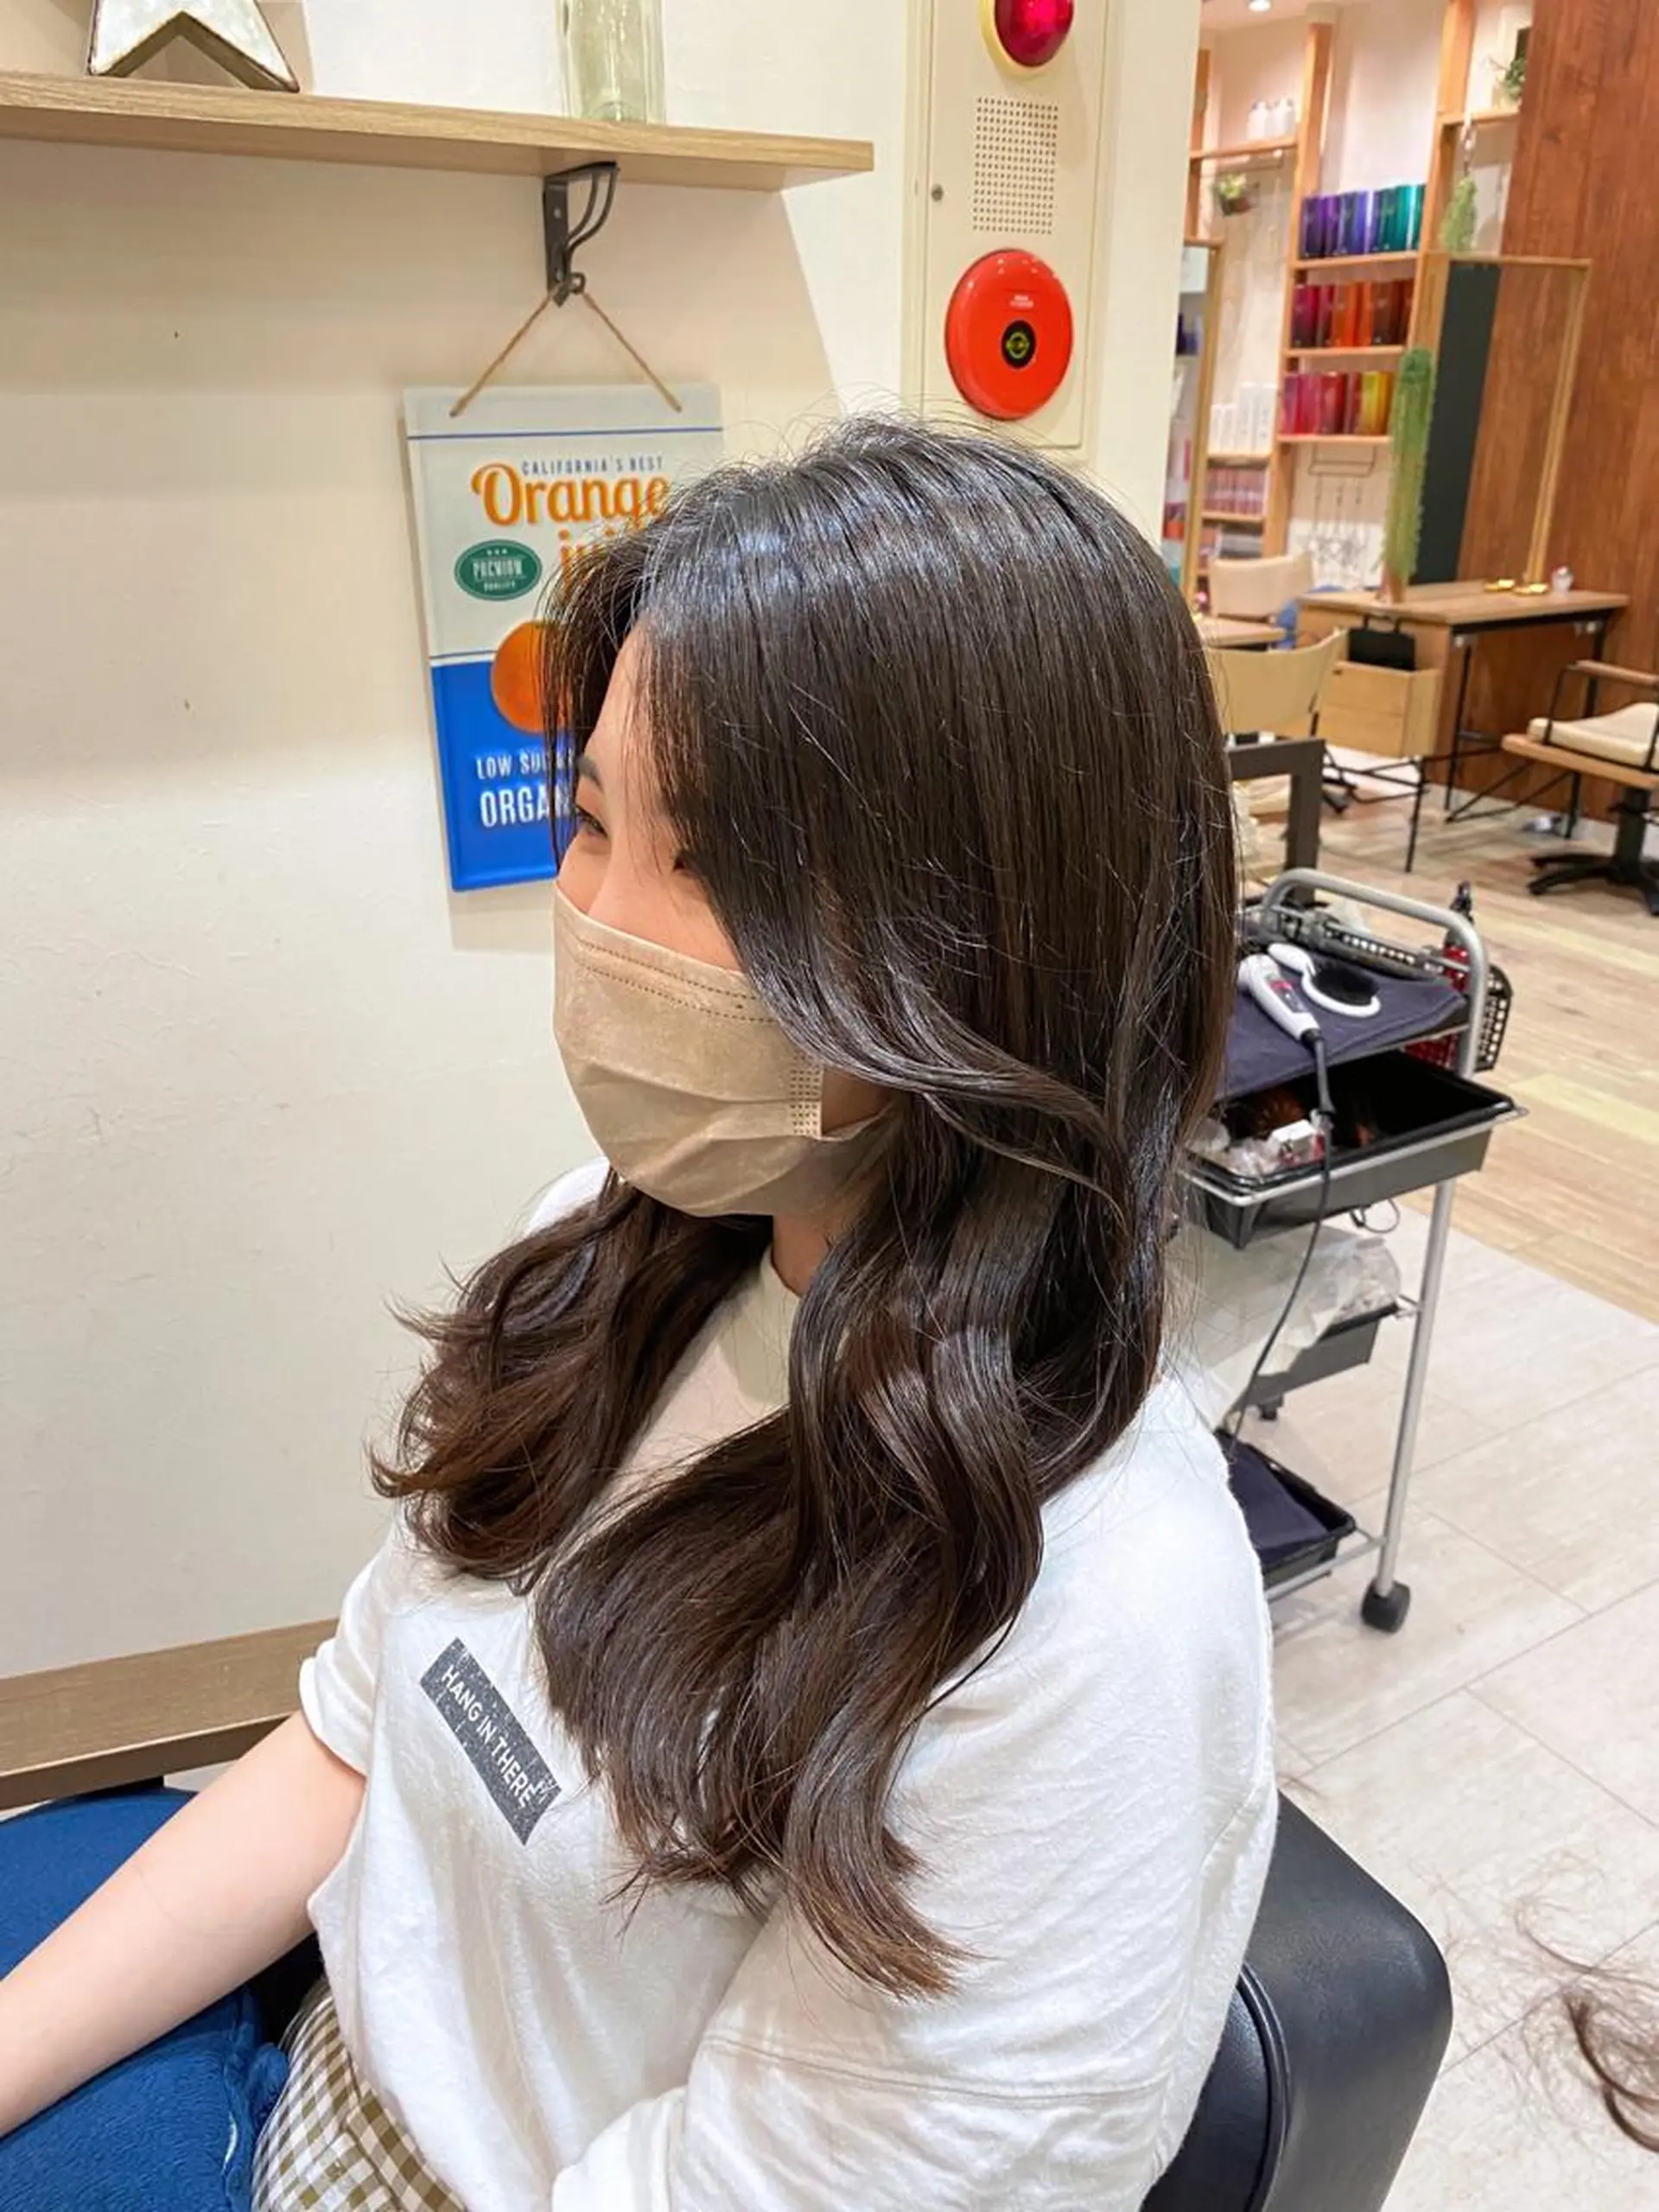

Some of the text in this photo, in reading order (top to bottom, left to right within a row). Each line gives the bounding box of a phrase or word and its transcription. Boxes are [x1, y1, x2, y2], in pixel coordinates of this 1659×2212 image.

[521, 454, 663, 476] CALIFORNIA'S BEST
[471, 461, 671, 529] Orange
[476, 754, 512, 780] LOW
[442, 1665, 537, 1808] HANG IN THERE
